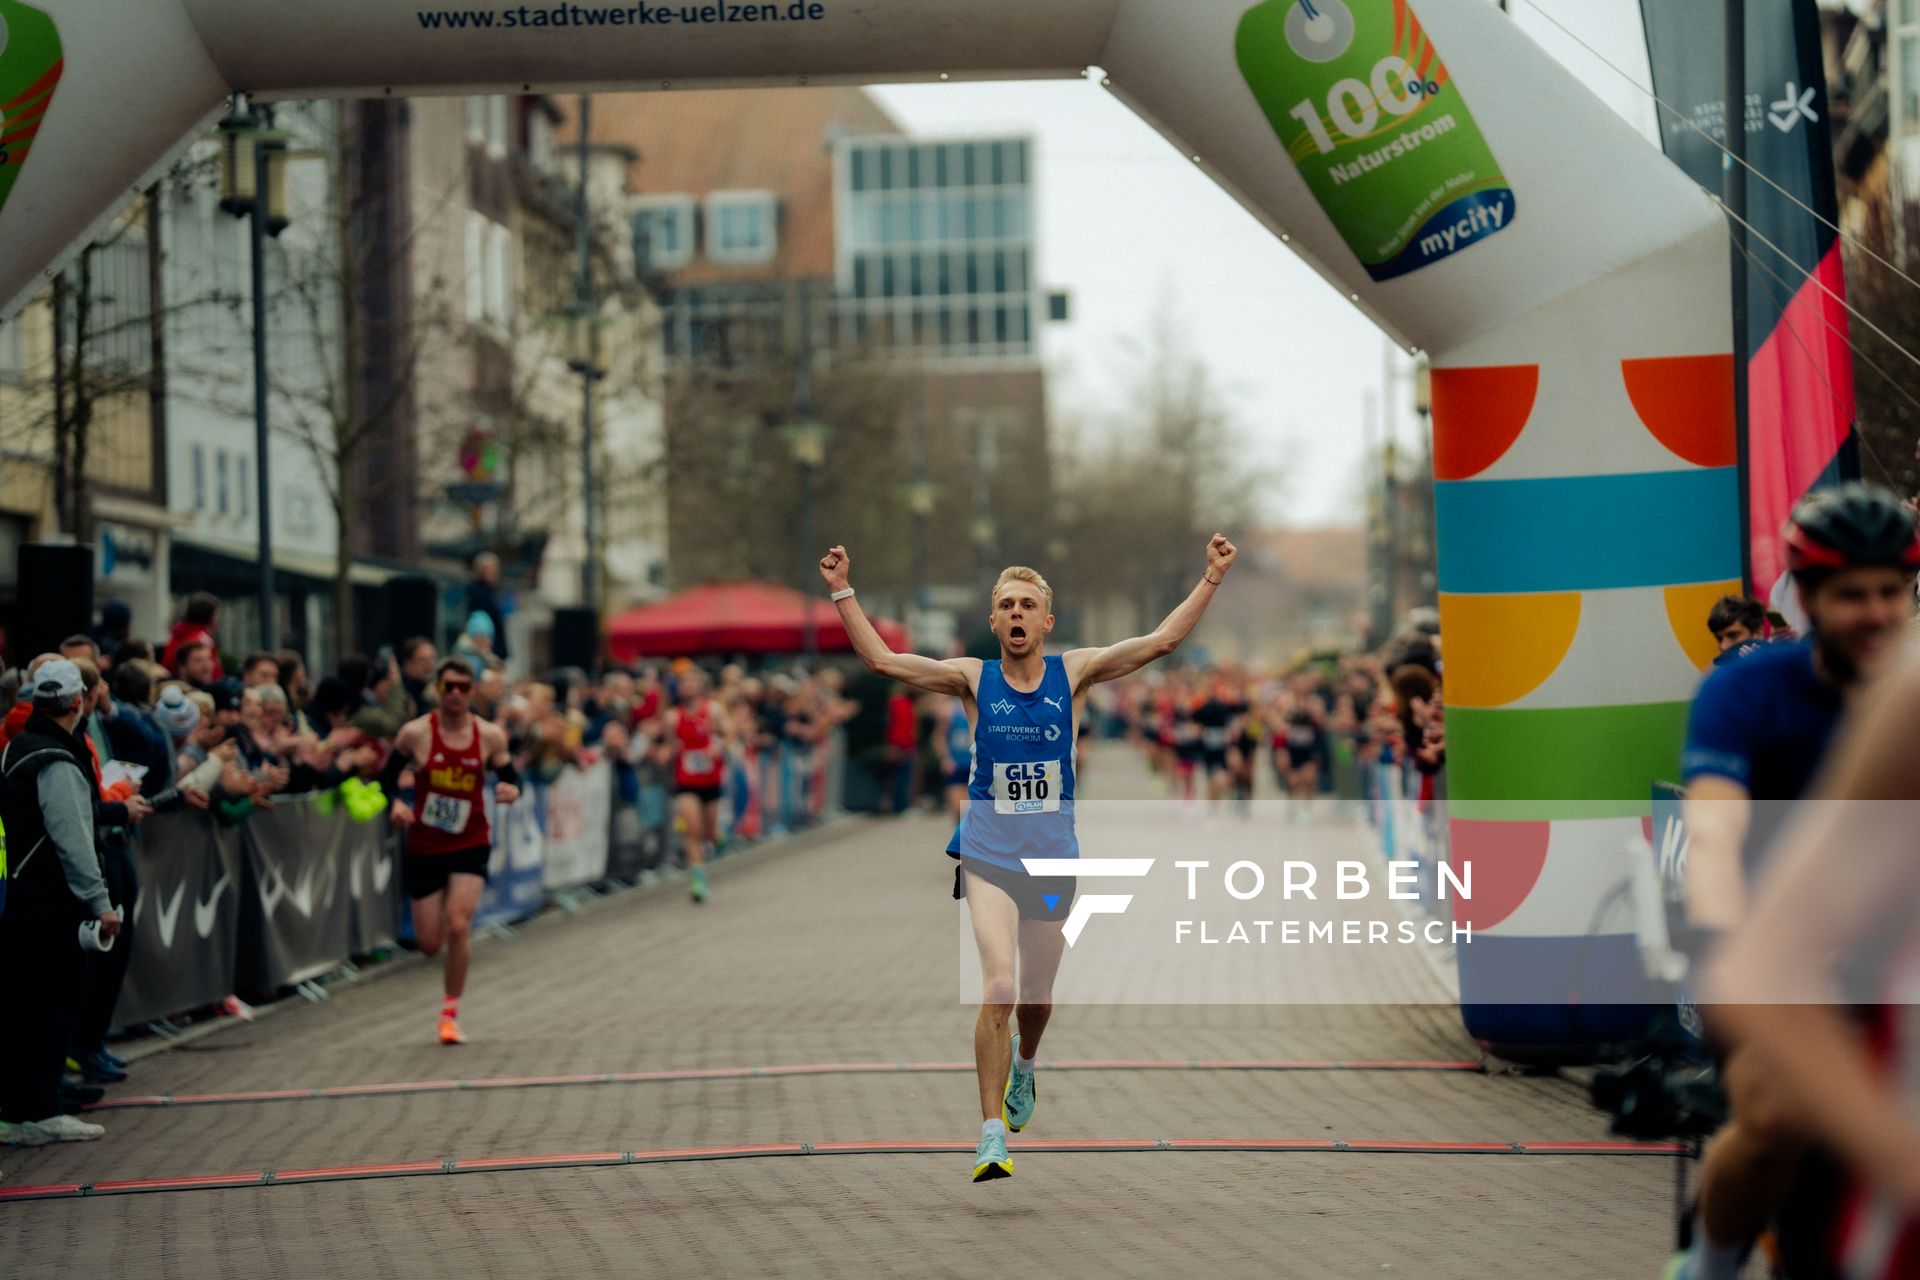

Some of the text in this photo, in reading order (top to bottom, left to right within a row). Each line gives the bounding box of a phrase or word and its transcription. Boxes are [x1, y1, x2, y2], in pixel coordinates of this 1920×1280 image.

[418, 0, 825, 29] www.stadtwerke-uelzen.de
[1328, 113, 1457, 184] Naturstrom
[1420, 201, 1504, 256] mycity
[987, 725, 1041, 734] STADTWERKE
[1006, 734, 1041, 742] BOCHUM
[1008, 779, 1049, 801] 910
